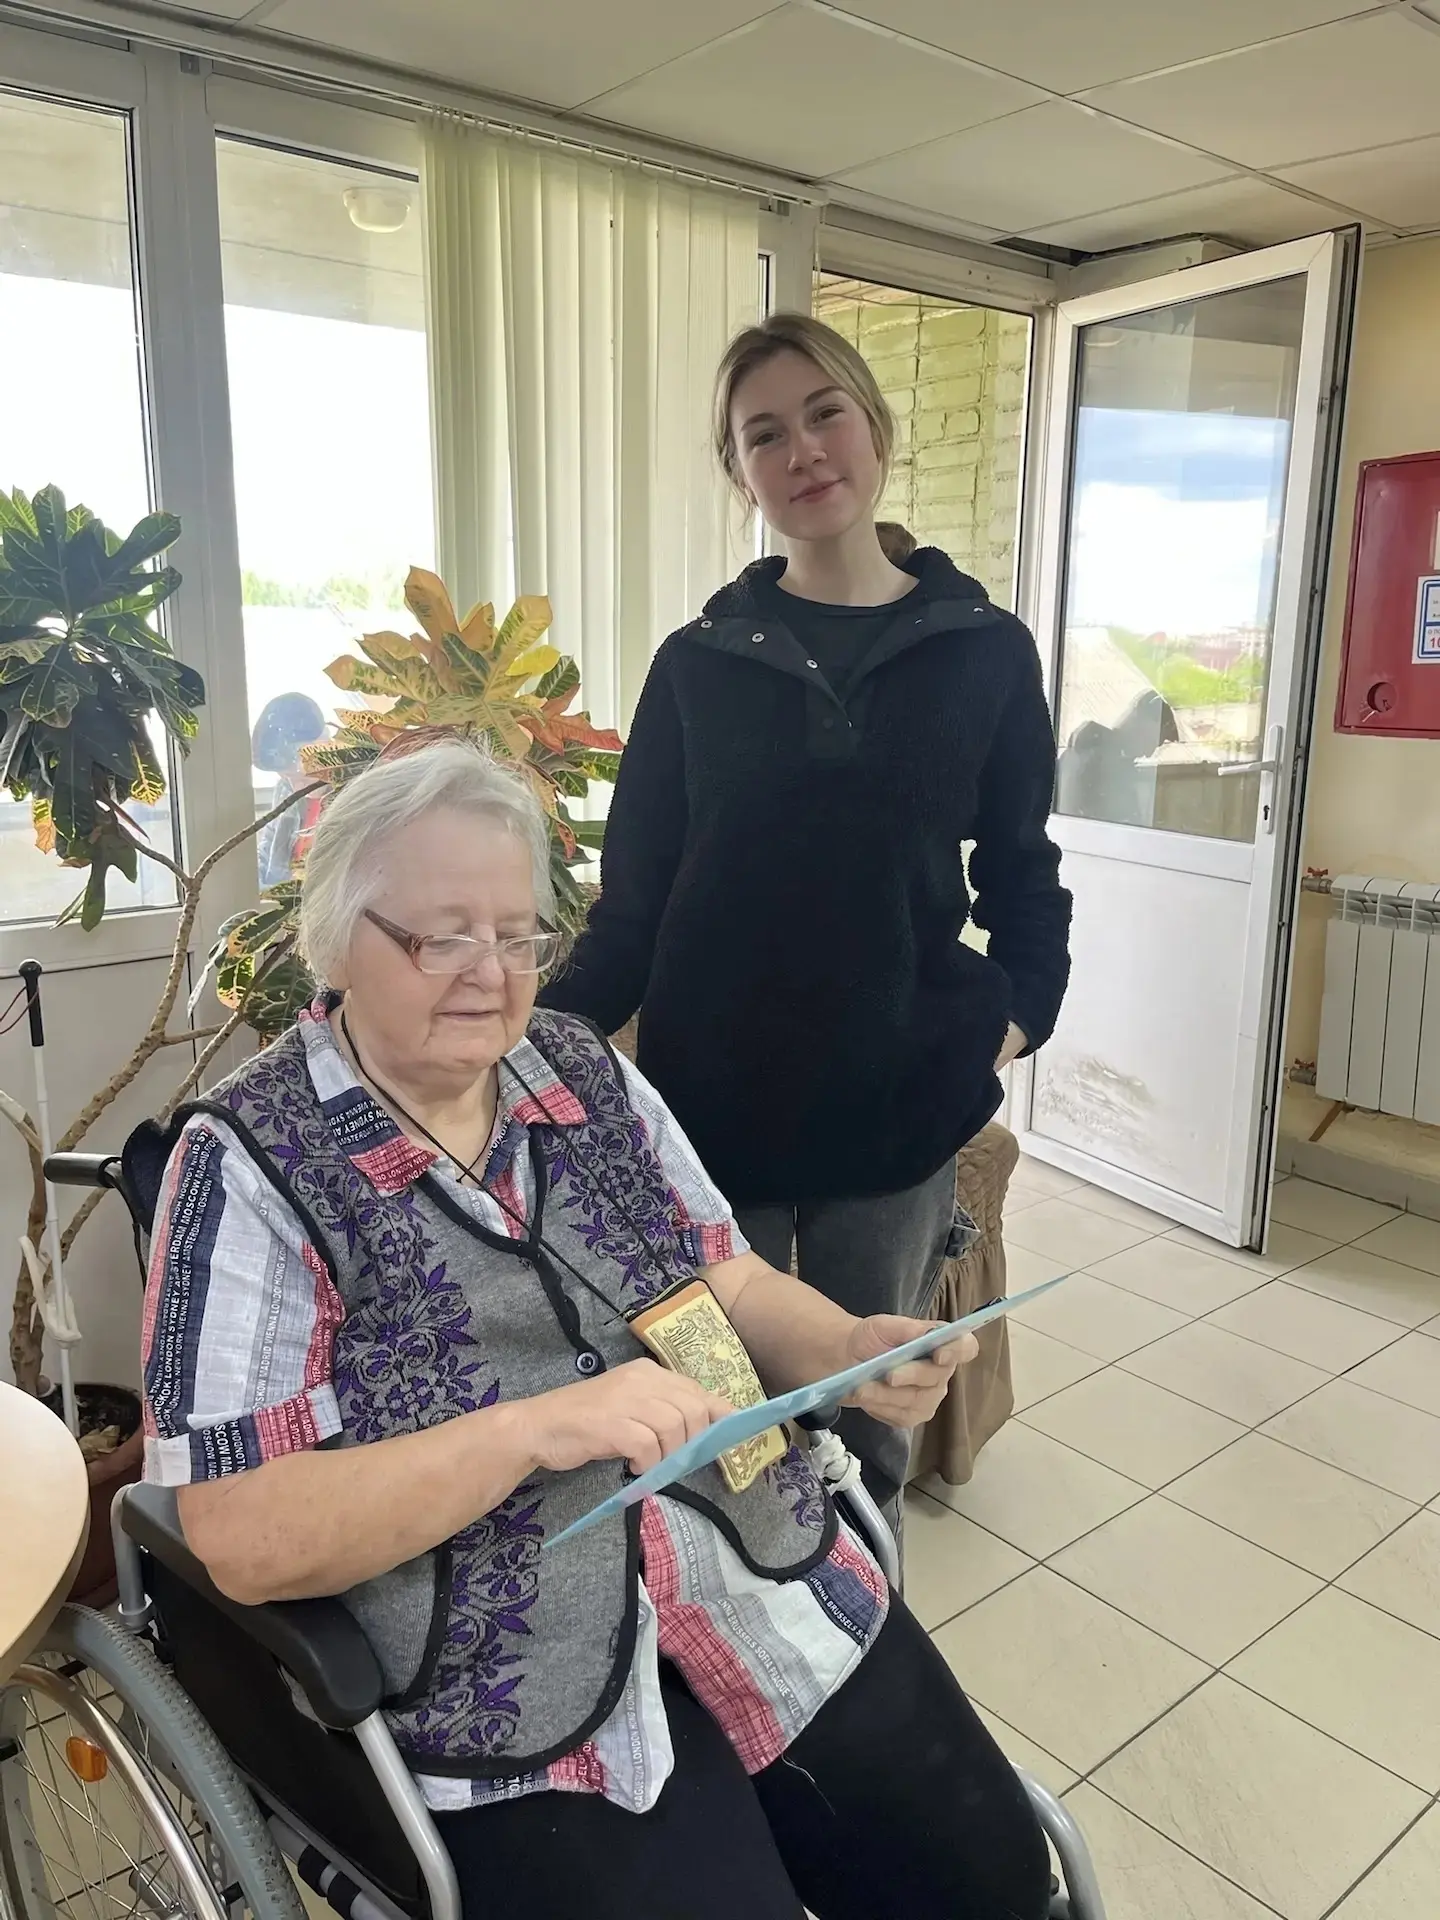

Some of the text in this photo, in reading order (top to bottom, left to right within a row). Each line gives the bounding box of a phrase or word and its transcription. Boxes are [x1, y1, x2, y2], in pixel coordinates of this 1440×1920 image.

[344, 1111, 375, 1134] SYDNEY
[181, 1179, 201, 1226] MOSCOW
[181, 1262, 192, 1299] SYDNEY
[274, 1262, 285, 1286] HONG
[168, 1291, 181, 1332] SYDNEY
[178, 1299, 189, 1330] VIENNA
[175, 1332, 184, 1357] YORK
[265, 1315, 278, 1345] VIENNA
[164, 1335, 176, 1378] LONDON
[260, 1346, 272, 1377] MADRID
[301, 1412, 316, 1443] MADRID
[674, 1507, 691, 1545] BANGKOK
[687, 1544, 696, 1562] NEW
[690, 1561, 699, 1588] YORK
[826, 1600, 858, 1631] BRUSSELS
[728, 1614, 757, 1648] BRUSSELS
[754, 1646, 774, 1669] SOFIA
[768, 1666, 790, 1697] PRAGUE
[630, 1731, 643, 1766] LONDON
